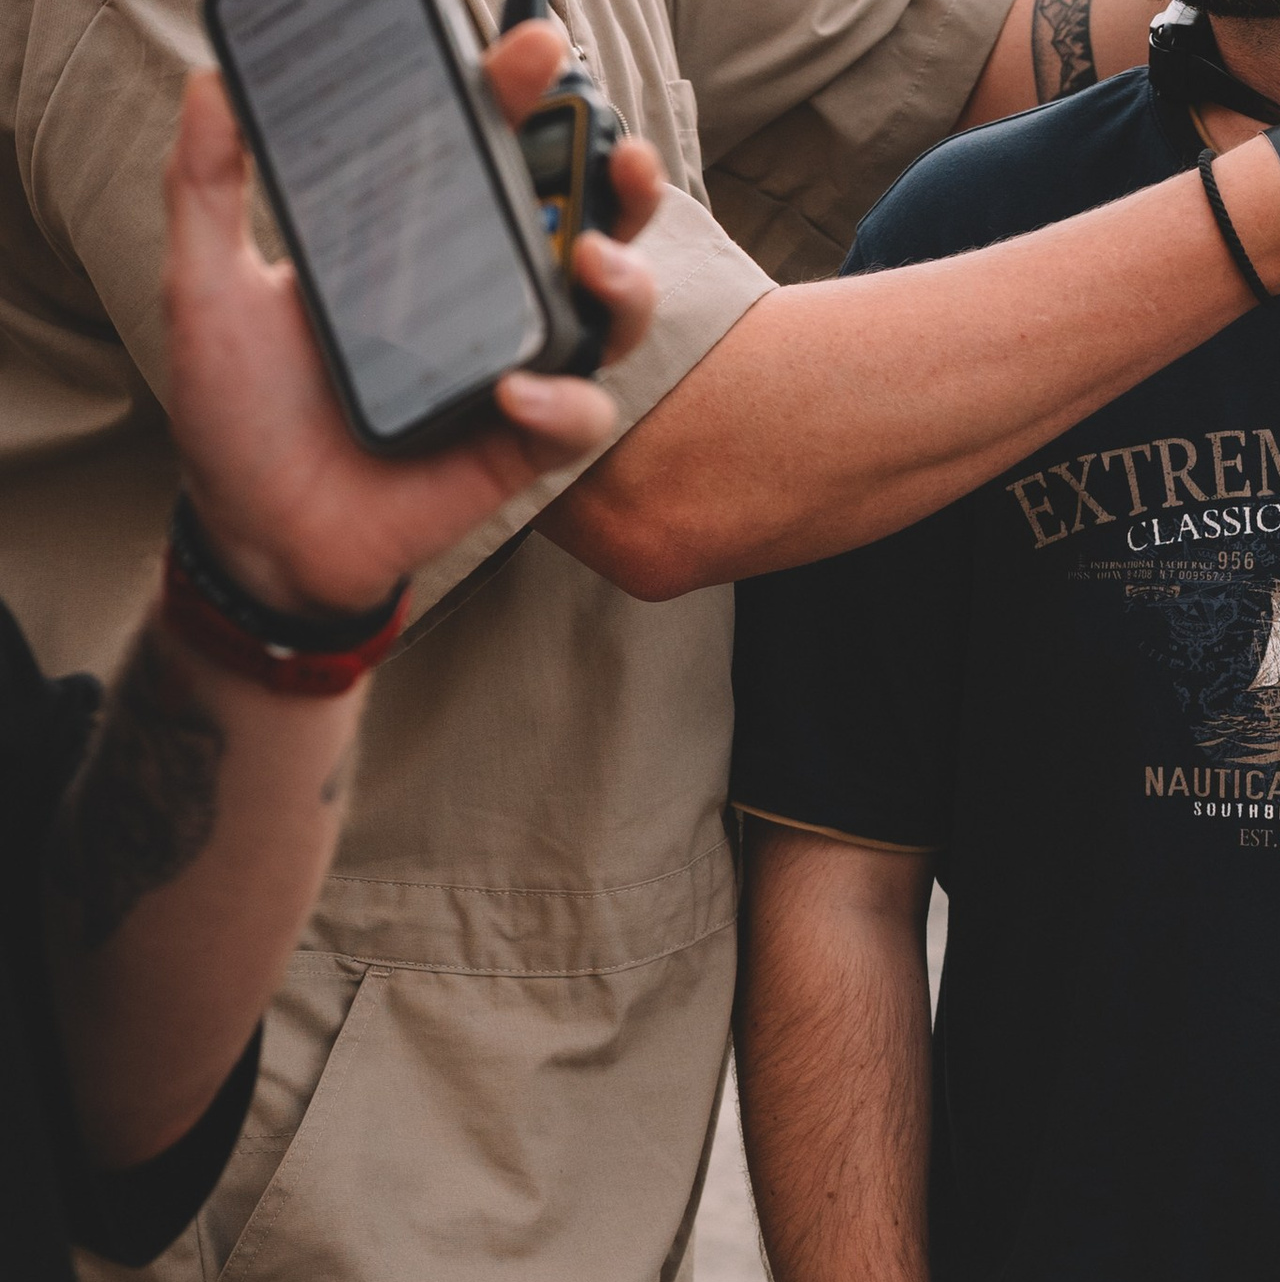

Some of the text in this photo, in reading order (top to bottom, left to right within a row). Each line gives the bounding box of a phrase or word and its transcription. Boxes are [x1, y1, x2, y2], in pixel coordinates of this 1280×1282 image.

[1090, 559, 1154, 570] INTERNATIONAL
[1159, 560, 1188, 570] YACHT
[1217, 550, 1255, 571] 956
[1239, 828, 1278, 849] EST.
